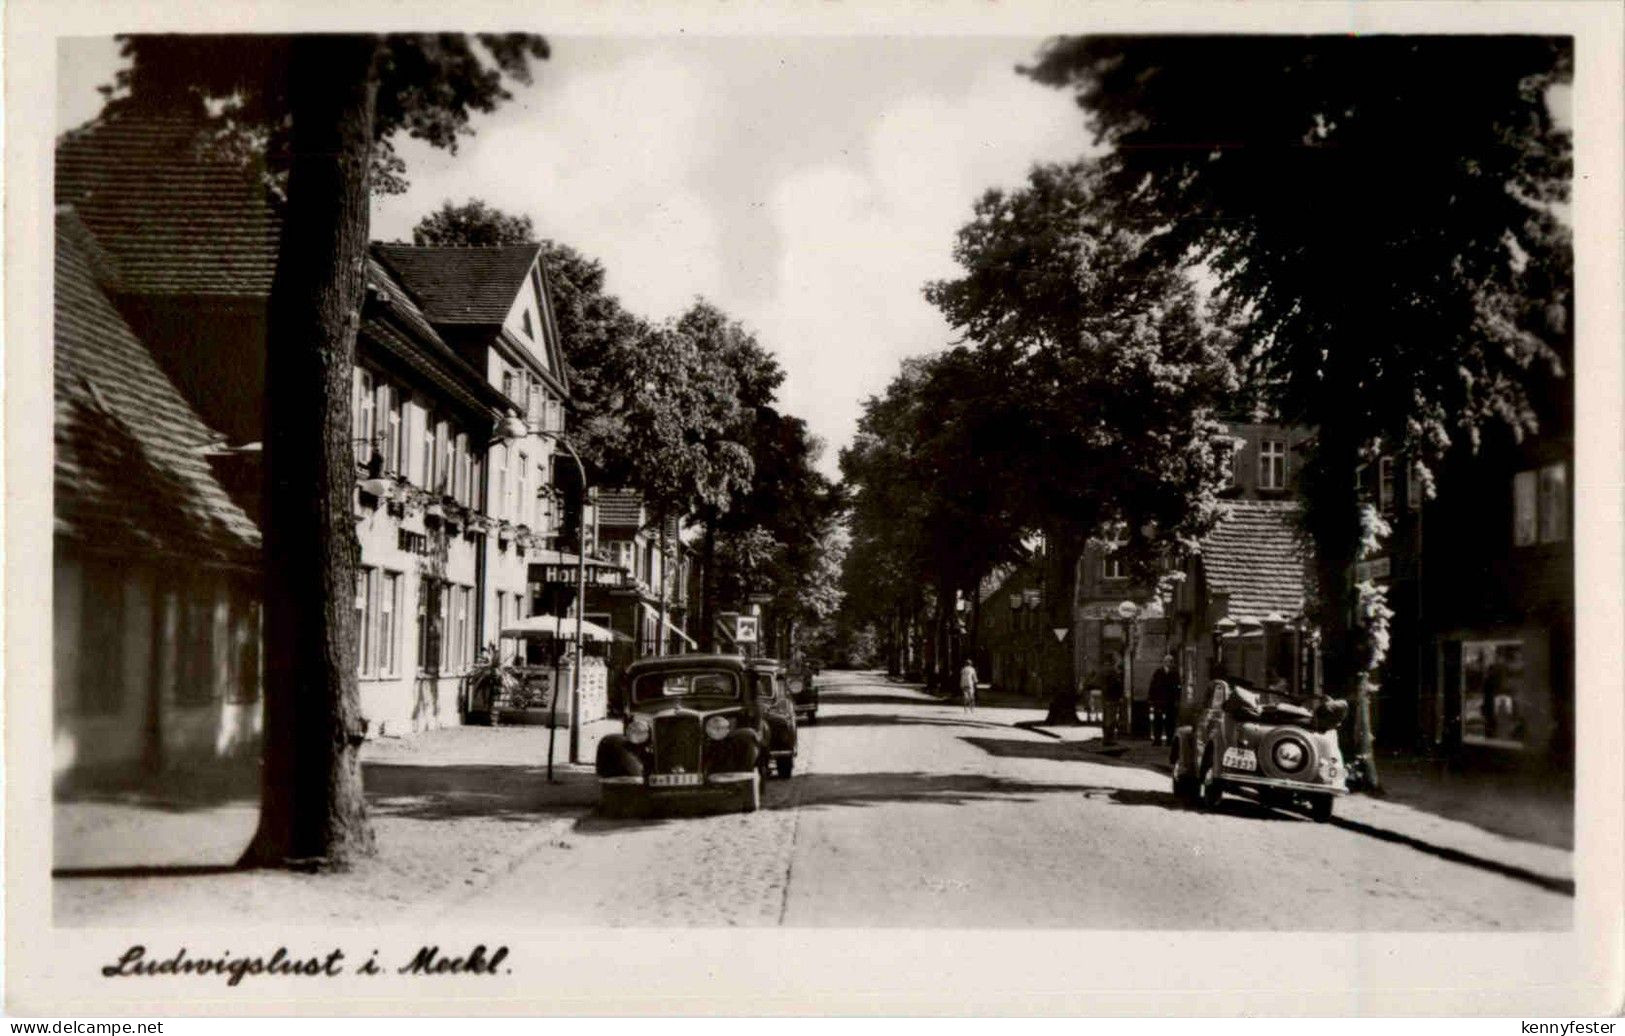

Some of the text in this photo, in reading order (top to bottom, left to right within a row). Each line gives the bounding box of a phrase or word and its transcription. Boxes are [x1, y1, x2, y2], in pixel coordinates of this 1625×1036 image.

[546, 566, 594, 583] Hotel
[101, 945, 345, 987] Ludwigslust
[397, 944, 512, 976] Meckl.
